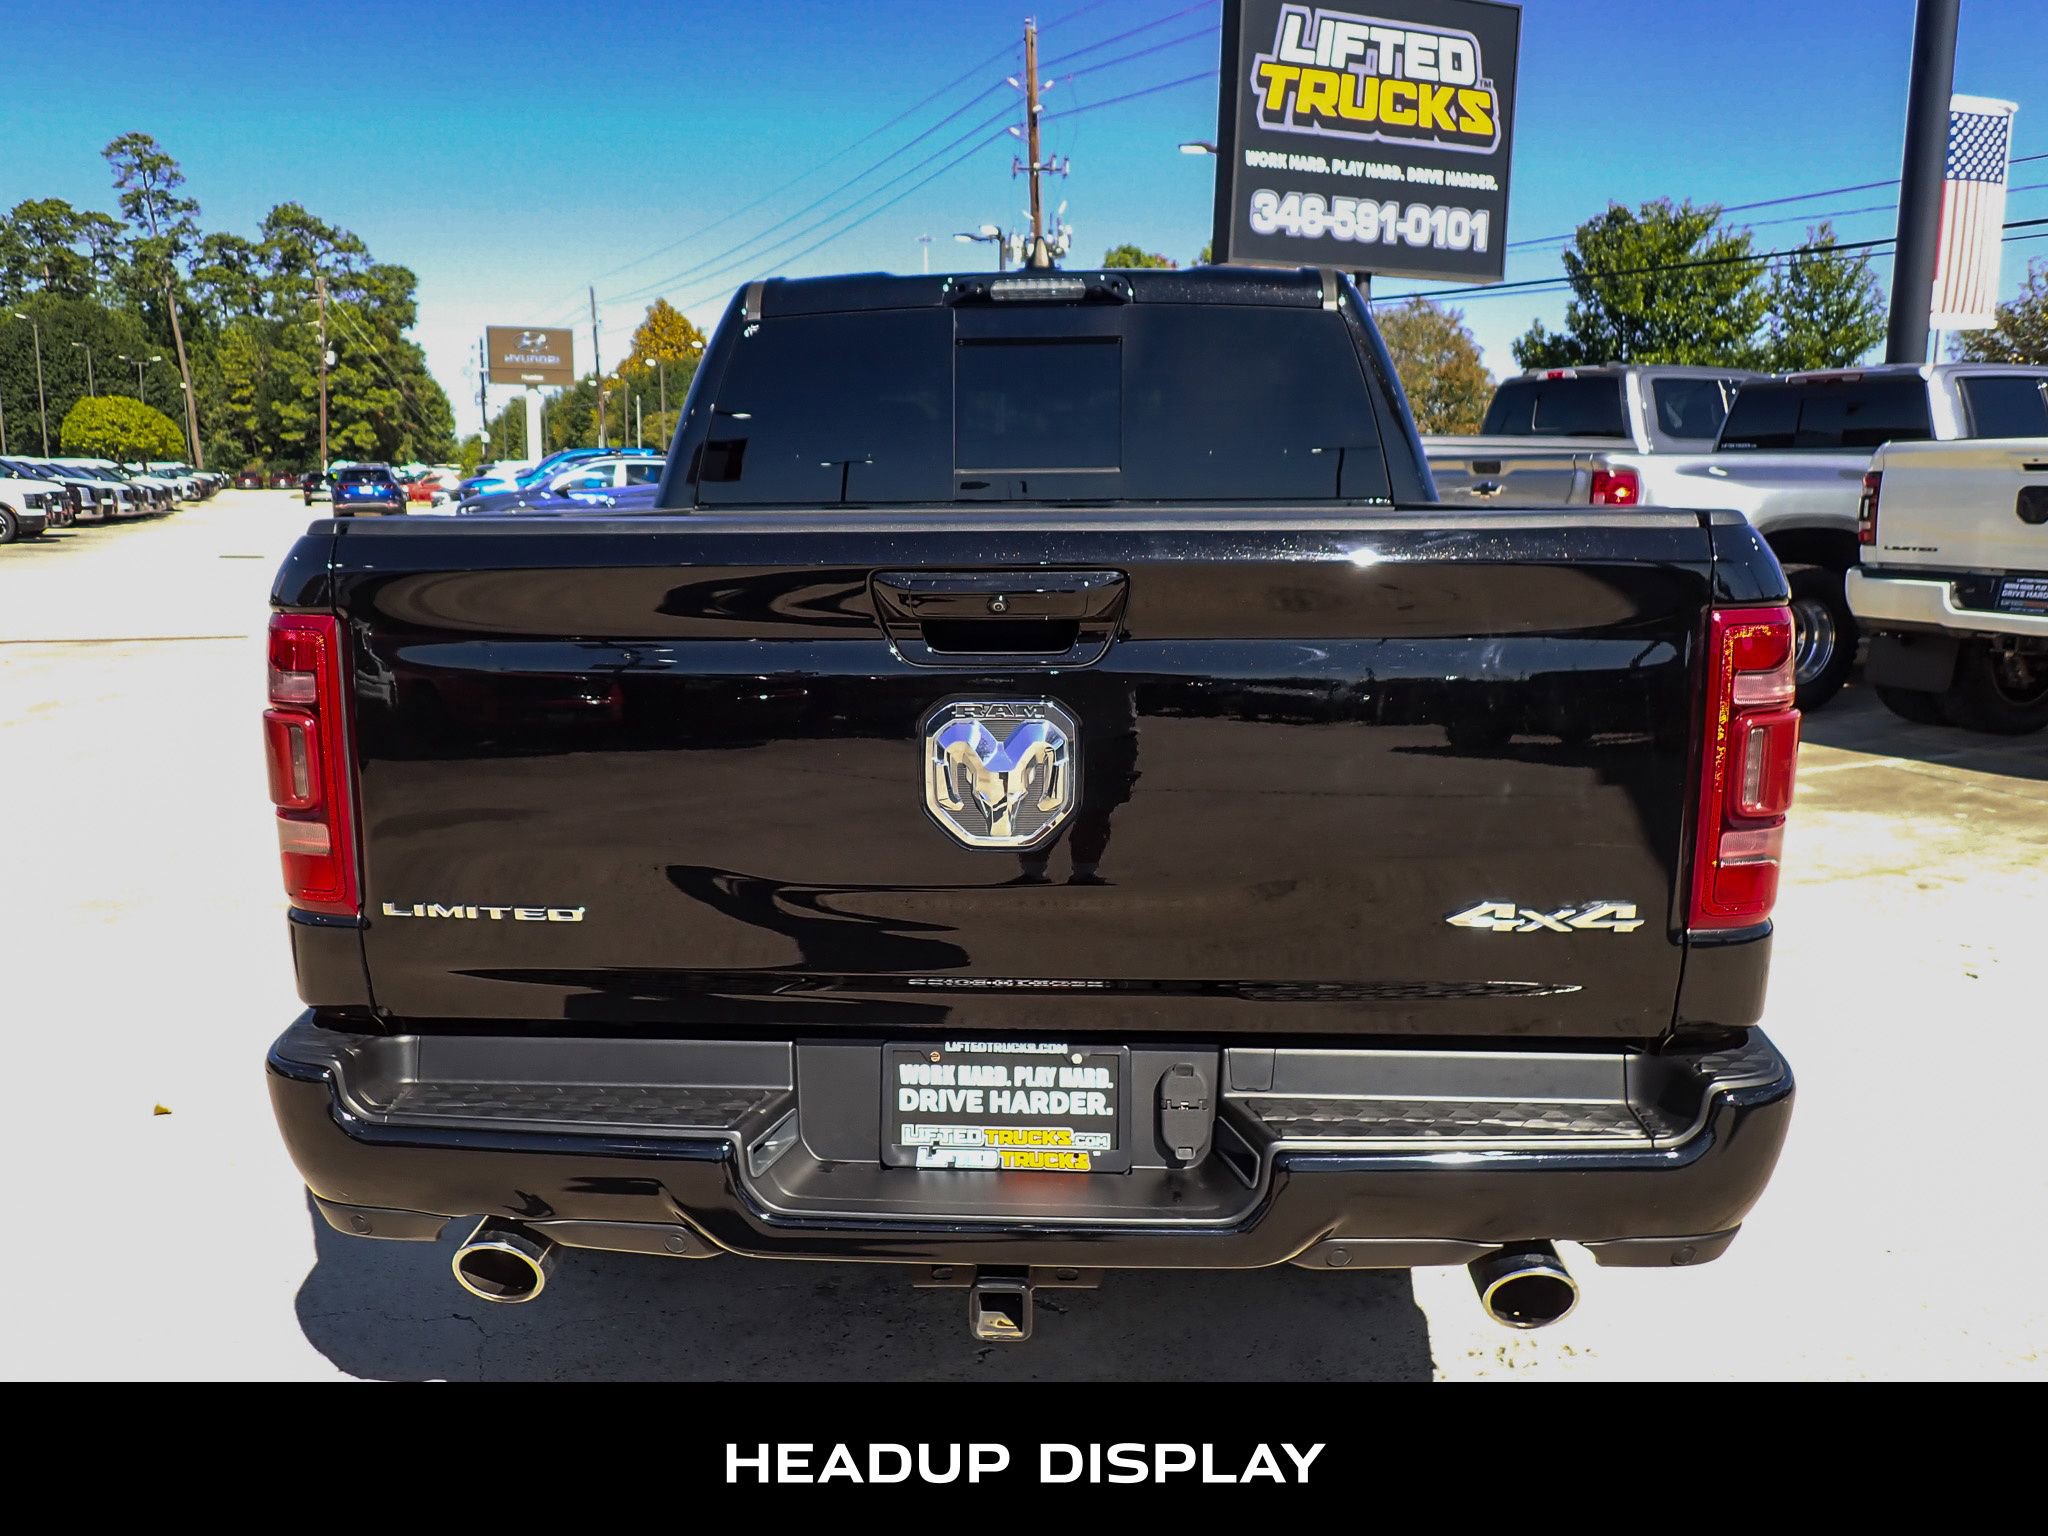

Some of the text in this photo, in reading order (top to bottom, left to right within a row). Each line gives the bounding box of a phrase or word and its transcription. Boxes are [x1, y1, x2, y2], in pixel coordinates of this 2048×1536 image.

[1279, 14, 1475, 86] LIFTED
[1260, 63, 1494, 136] TRUCKS
[1245, 150, 1287, 169] WORK
[1332, 158, 1364, 177] PLAY
[1407, 166, 1444, 185] DRIVE
[953, 703, 1045, 718] RAM
[382, 902, 585, 922] LIMITED
[899, 1064, 955, 1086] WORK
[1014, 1066, 1057, 1087] PLAY
[898, 1088, 1114, 1116] DRIVE HARDER.
